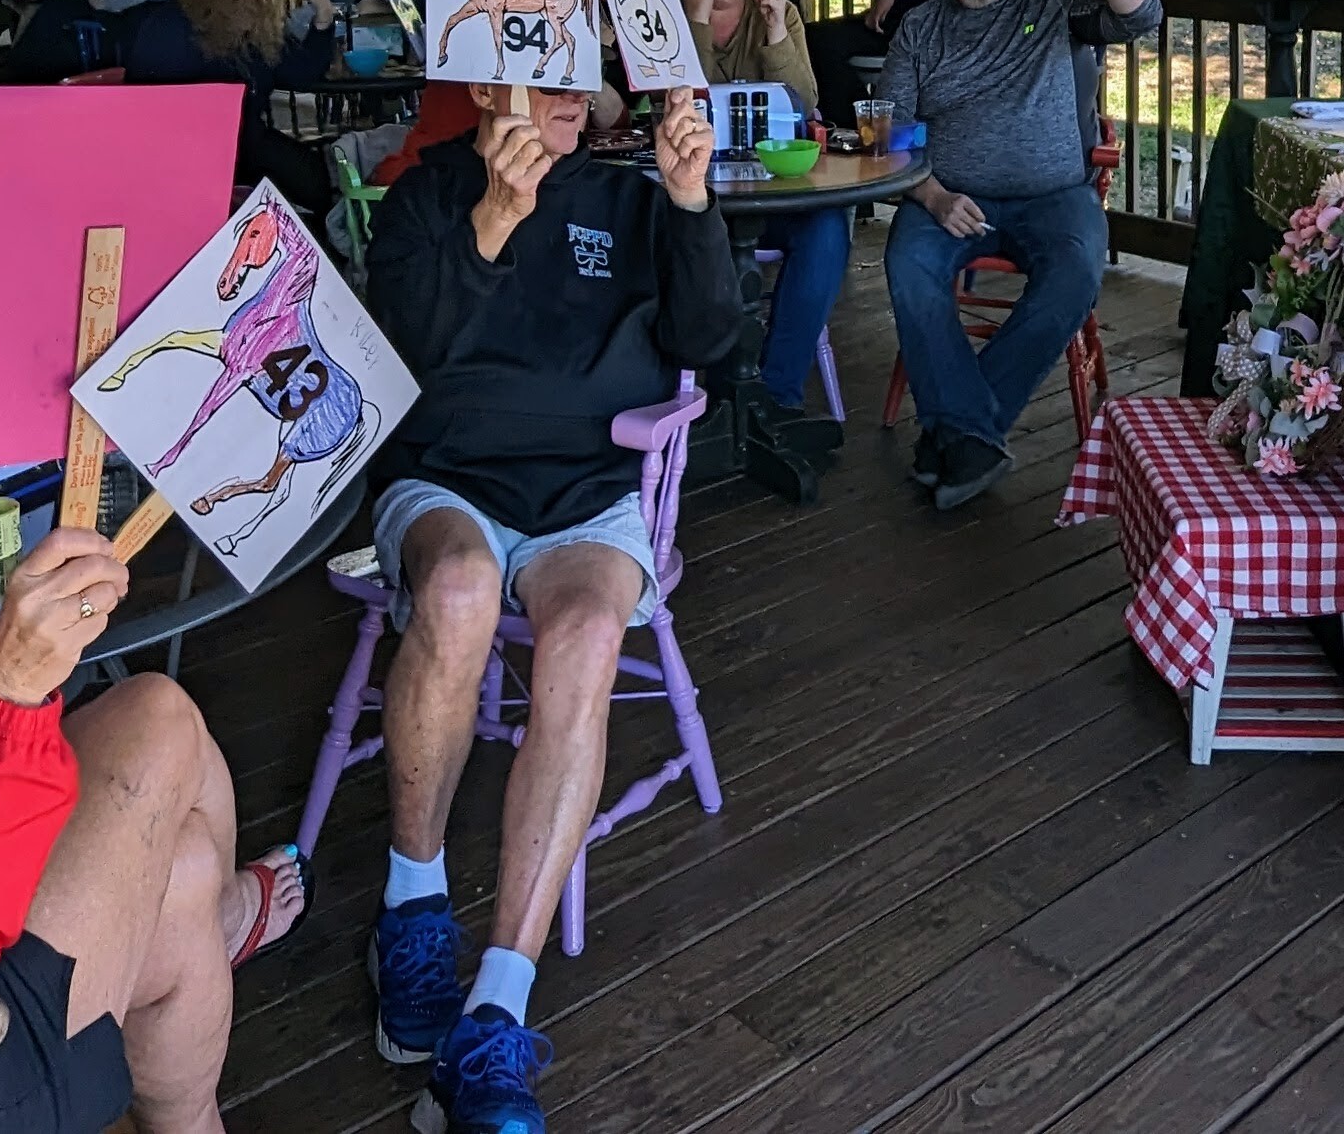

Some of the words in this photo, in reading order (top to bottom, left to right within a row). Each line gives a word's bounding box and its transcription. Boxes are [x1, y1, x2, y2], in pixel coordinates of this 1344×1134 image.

[502, 15, 549, 54] 94
[634, 8, 668, 43] 34
[261, 344, 329, 421] 43
